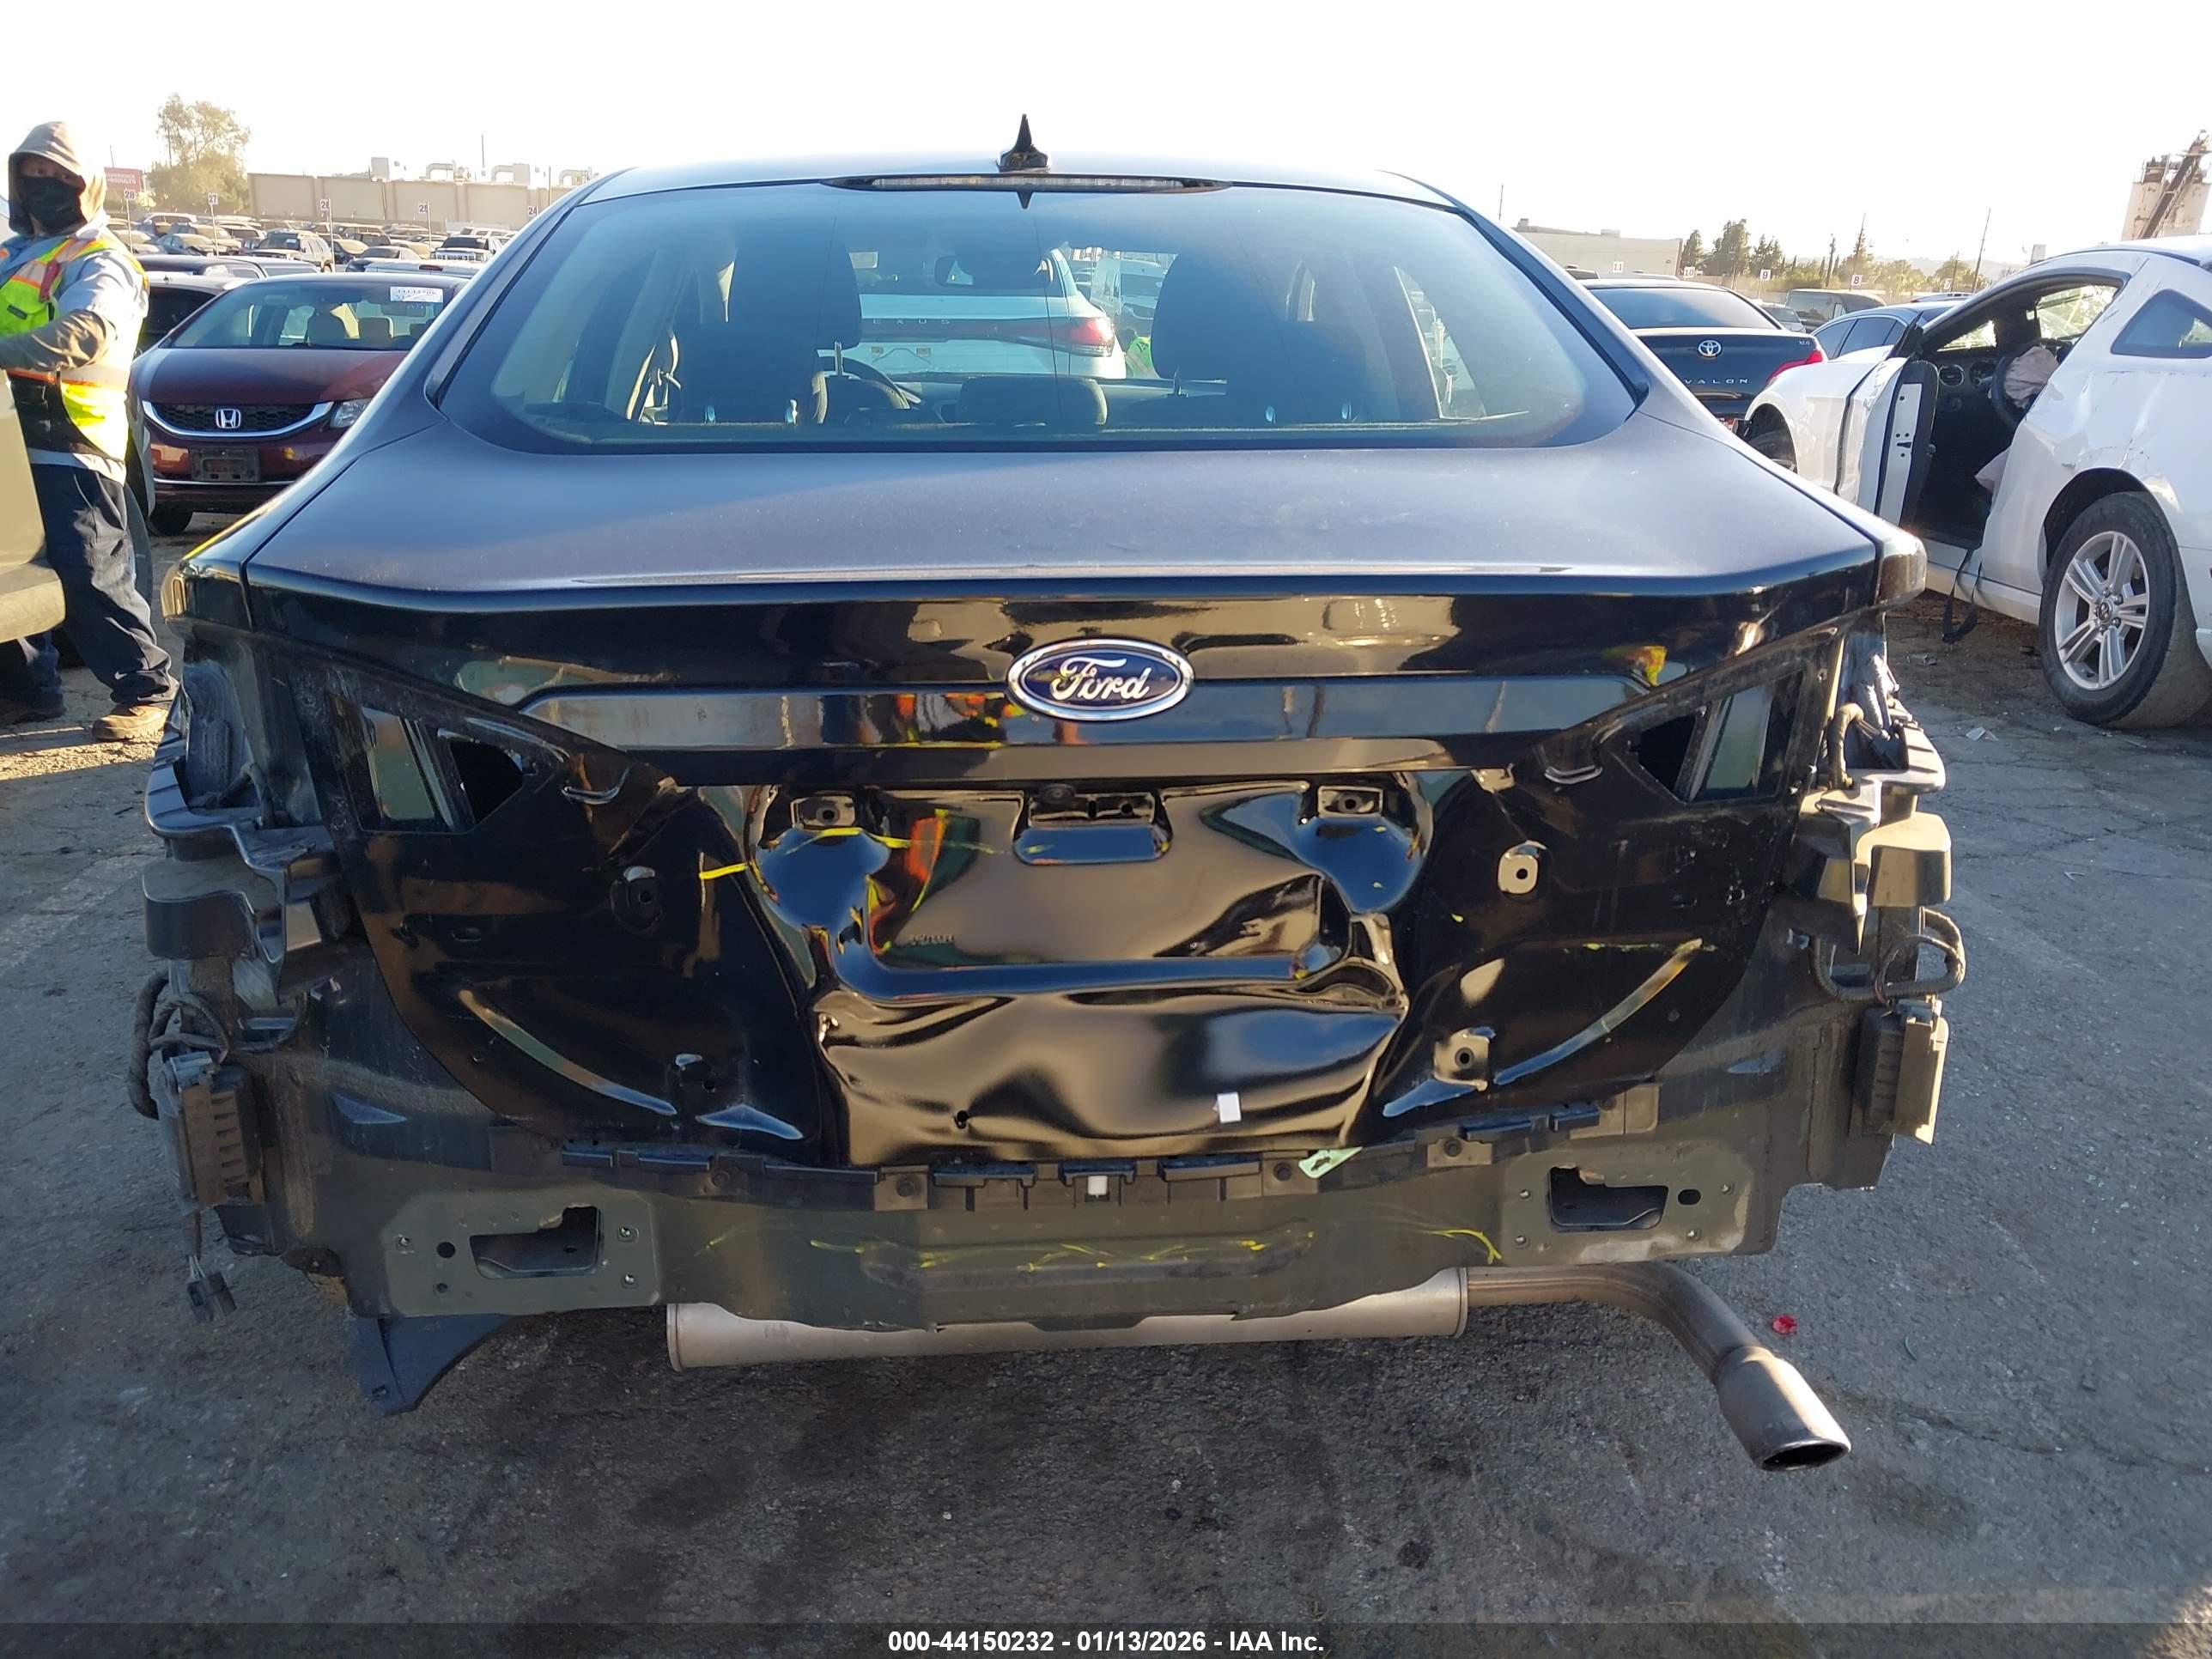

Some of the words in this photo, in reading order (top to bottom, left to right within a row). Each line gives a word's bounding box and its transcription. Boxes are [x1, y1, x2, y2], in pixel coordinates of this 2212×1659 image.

[125, 191, 135, 199] 28
[209, 195, 216, 204] 27
[1854, 276, 1859, 284] 8
[1050, 657, 1152, 700] Ford
